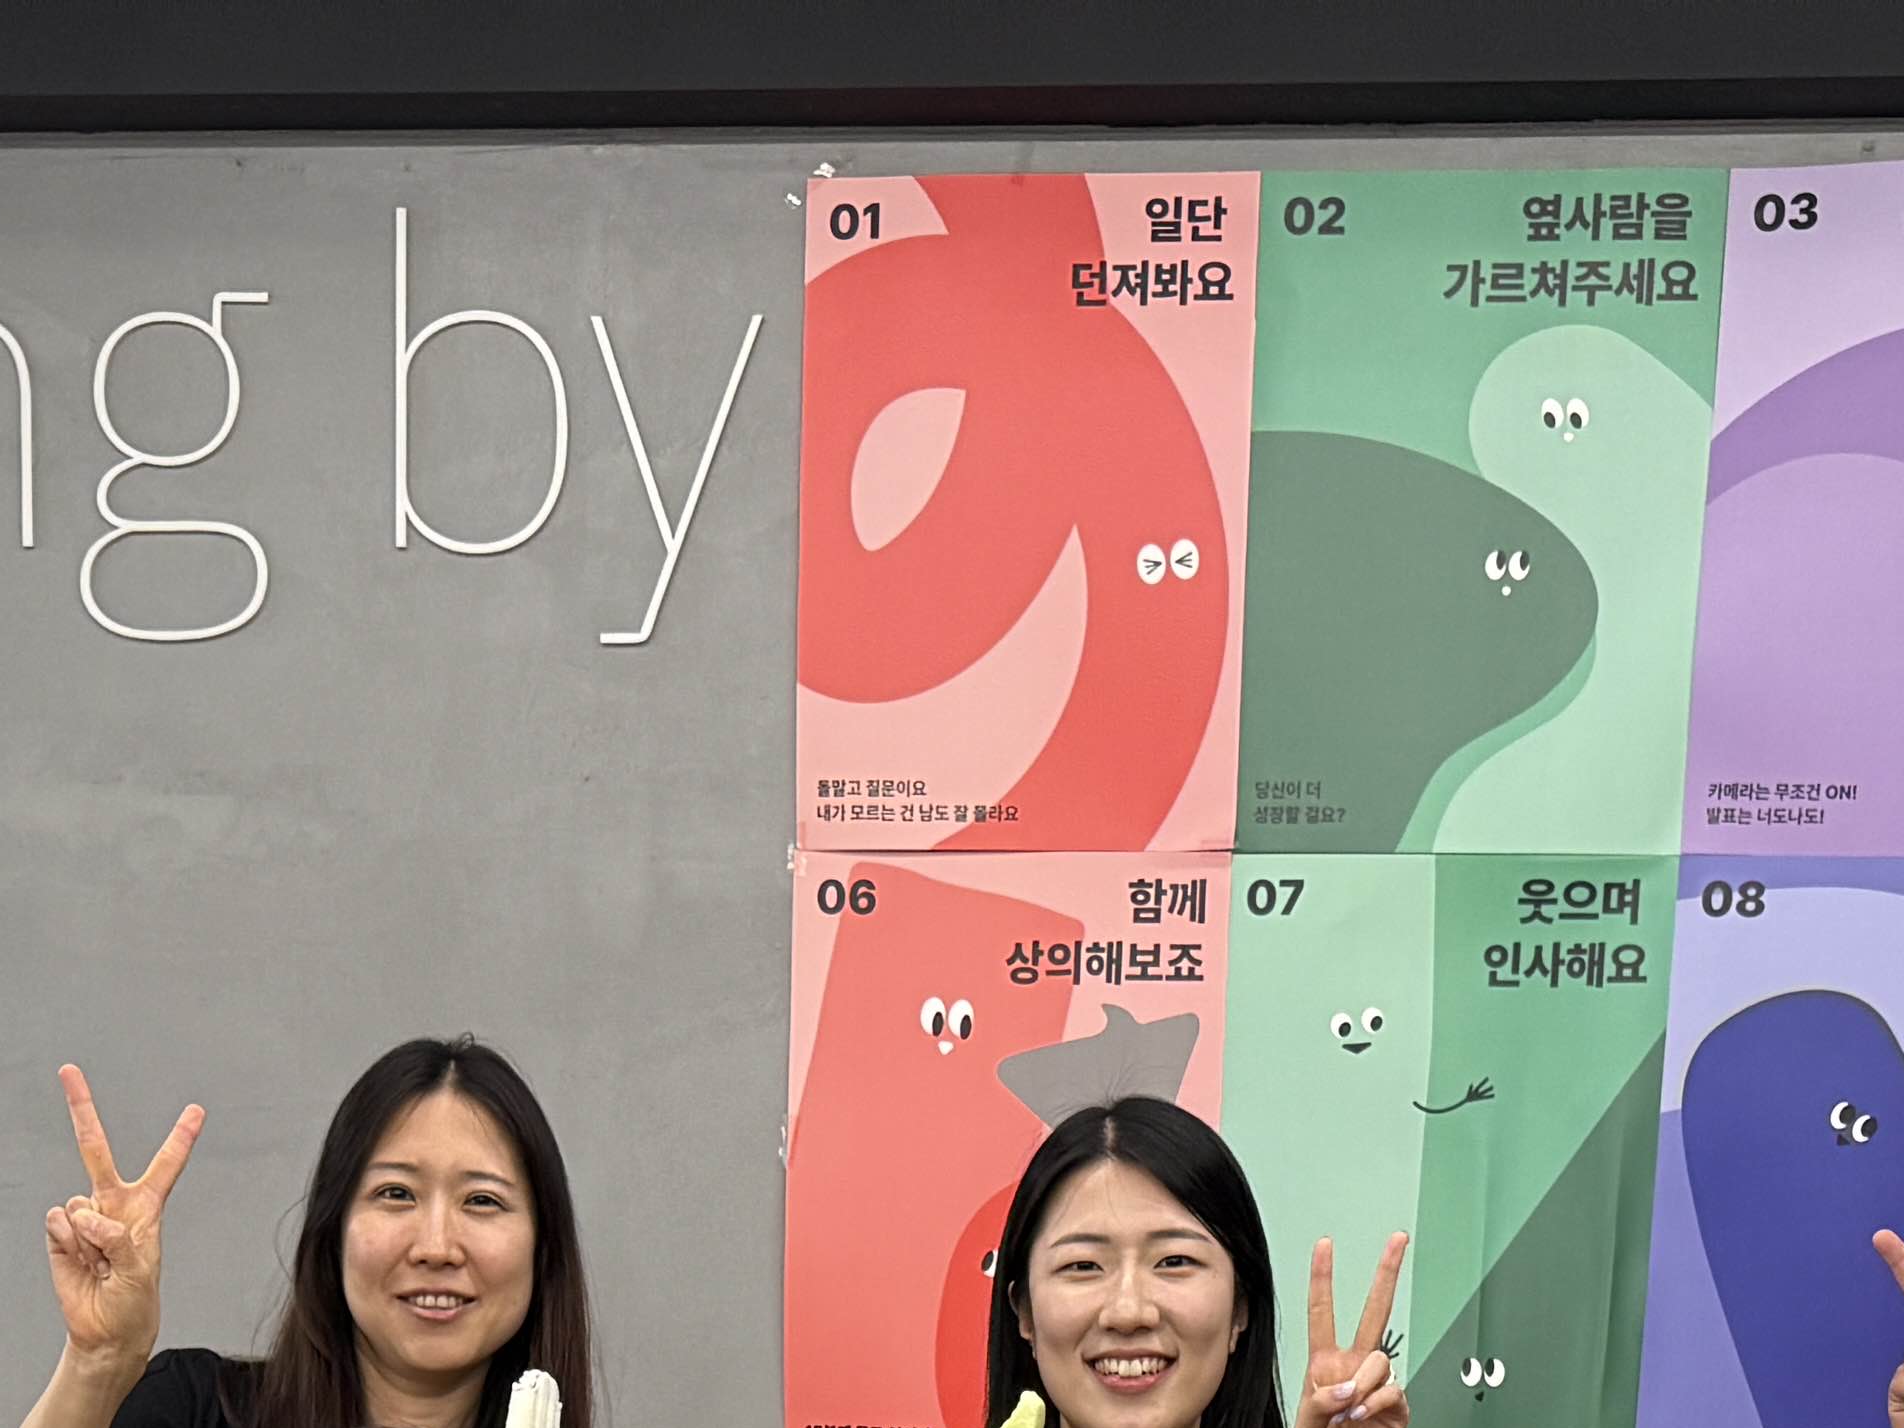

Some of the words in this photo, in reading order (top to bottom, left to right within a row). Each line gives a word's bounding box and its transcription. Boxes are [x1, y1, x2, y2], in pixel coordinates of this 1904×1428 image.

[830, 202, 881, 239] 01
[1144, 197, 1226, 243] 일단
[1283, 196, 1346, 236] 02
[1522, 195, 1693, 242] 옆사람을
[1754, 192, 1818, 231] 03
[1072, 261, 1233, 307] 던져봐요
[1443, 260, 1698, 307] 가르쳐주세요
[396, 207, 763, 644] by
[867, 780, 927, 796] 질문이요
[1306, 781, 1322, 798] 더
[1708, 783, 1770, 800] 카메라는
[1774, 783, 1821, 800] 무조건
[1825, 784, 1858, 800] ON!
[817, 804, 845, 821] 내가
[850, 804, 895, 821] 모르는
[900, 804, 914, 821] 건
[919, 804, 950, 821] 남도
[1707, 808, 1752, 824] 발표는
[1757, 808, 1824, 825] 너도나도!
[817, 881, 876, 916] 06
[1128, 881, 1206, 924] 함께
[1247, 880, 1305, 916] 07
[1517, 881, 1640, 926] 웃으며
[1701, 881, 1766, 917] 08
[1005, 942, 1204, 987] 상의해보죠
[1484, 944, 1647, 989] 인사해요
